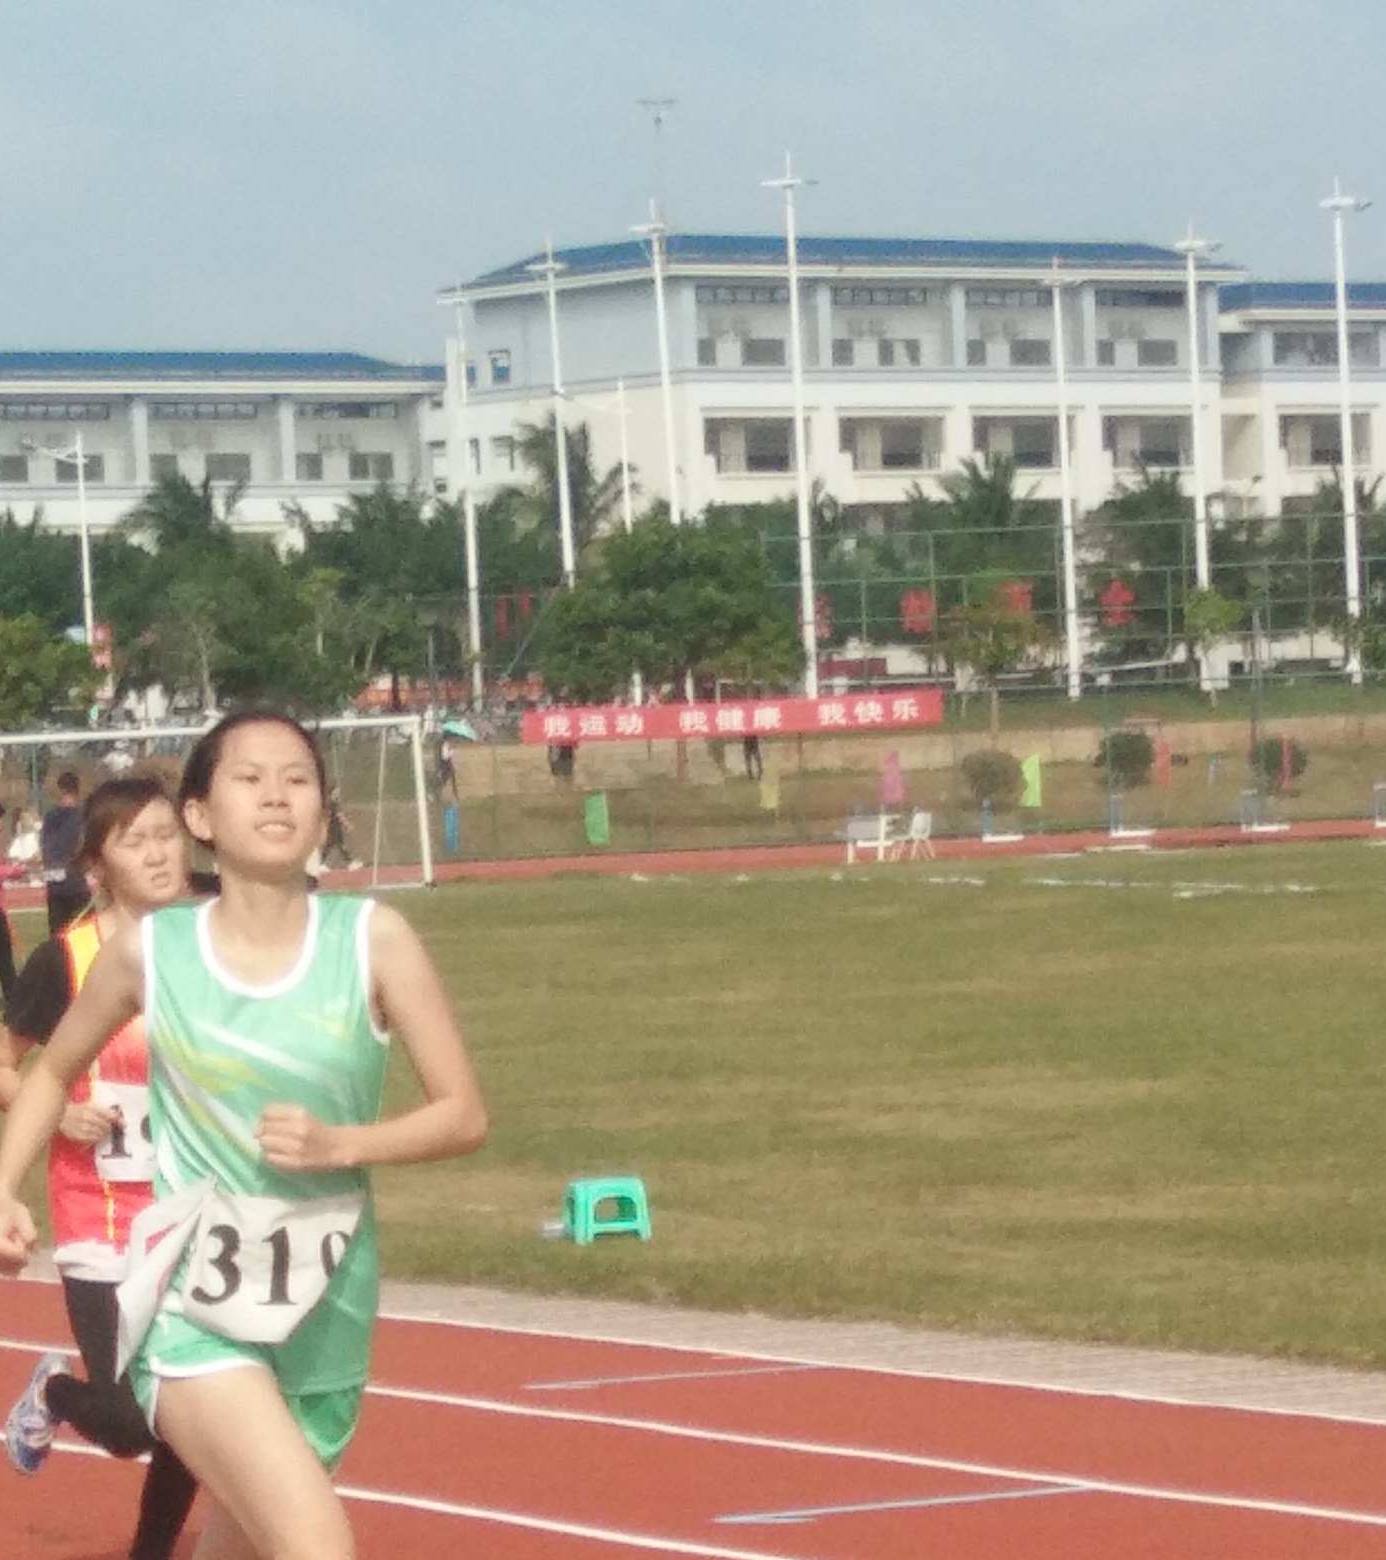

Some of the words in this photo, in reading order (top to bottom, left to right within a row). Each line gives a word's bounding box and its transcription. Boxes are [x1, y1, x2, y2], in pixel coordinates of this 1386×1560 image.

[542, 710, 646, 739] 我运动
[677, 704, 782, 734] 我健康
[816, 697, 921, 726] 我快乐
